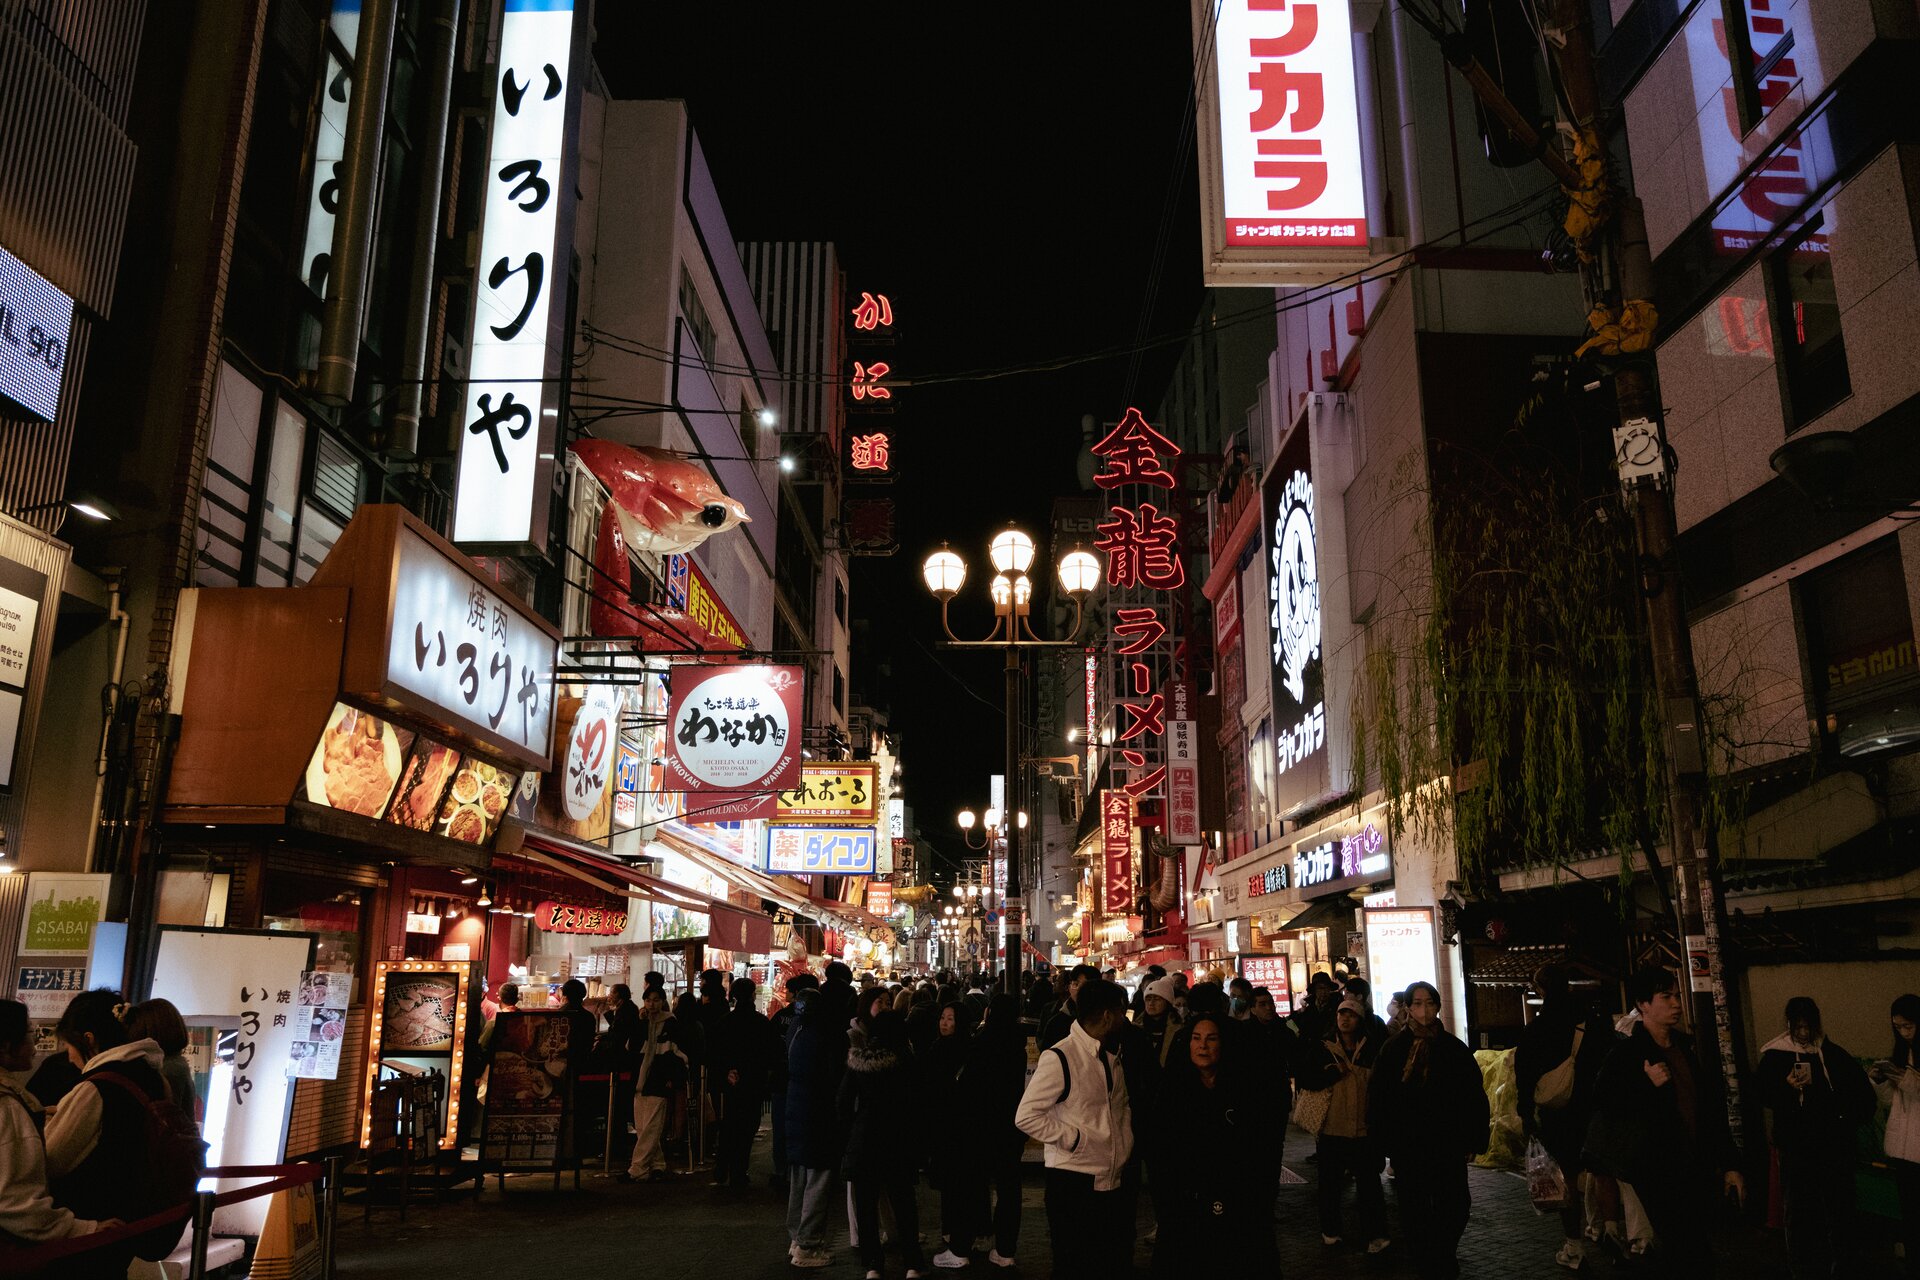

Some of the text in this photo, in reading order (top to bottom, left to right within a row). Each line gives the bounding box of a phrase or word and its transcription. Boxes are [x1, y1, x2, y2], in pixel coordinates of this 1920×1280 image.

[1235, 225, 1356, 237] ジャンボカラオケ広場
[469, 63, 563, 474] いろりや
[467, 583, 508, 648] 焼肉
[1092, 407, 1185, 799] 金龍ラーメン
[414, 621, 539, 747] いろりや
[677, 707, 778, 748] わなか
[1278, 701, 1324, 775] ジャンカラ
[668, 754, 701, 790] TAKOYAKI
[761, 755, 792, 787] WANAKA
[806, 834, 869, 867] ダイコク
[1106, 798, 1130, 911] 金龍ラーメン
[1294, 841, 1334, 889] ジャンカラ
[48, 920, 89, 935] SABAI
[25, 968, 82, 990] テナント募集
[273, 989, 292, 1027] 焼肉
[232, 986, 269, 1105] いろりや
